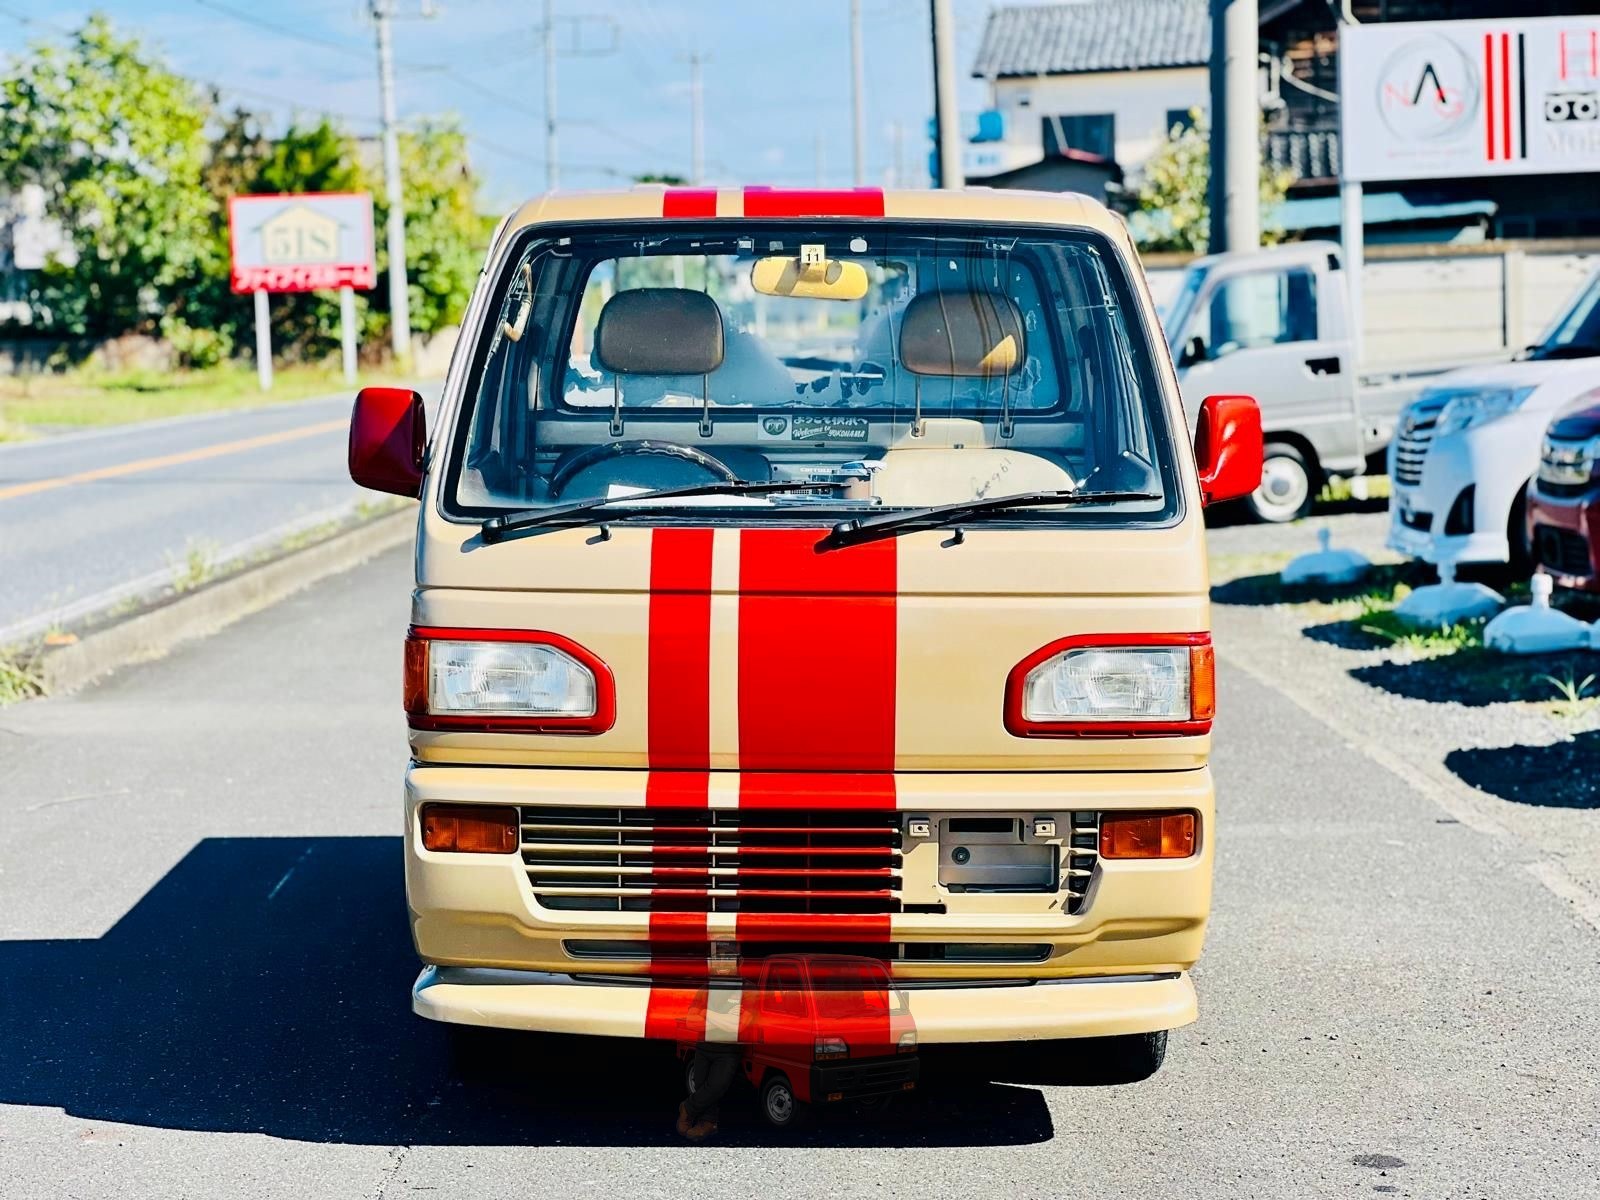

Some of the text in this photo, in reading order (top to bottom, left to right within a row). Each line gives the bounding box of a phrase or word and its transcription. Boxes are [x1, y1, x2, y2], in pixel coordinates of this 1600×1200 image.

[806, 253, 819, 262] 11
[792, 427, 824, 438] Welcome
[828, 429, 866, 439] YOKOHAMA
